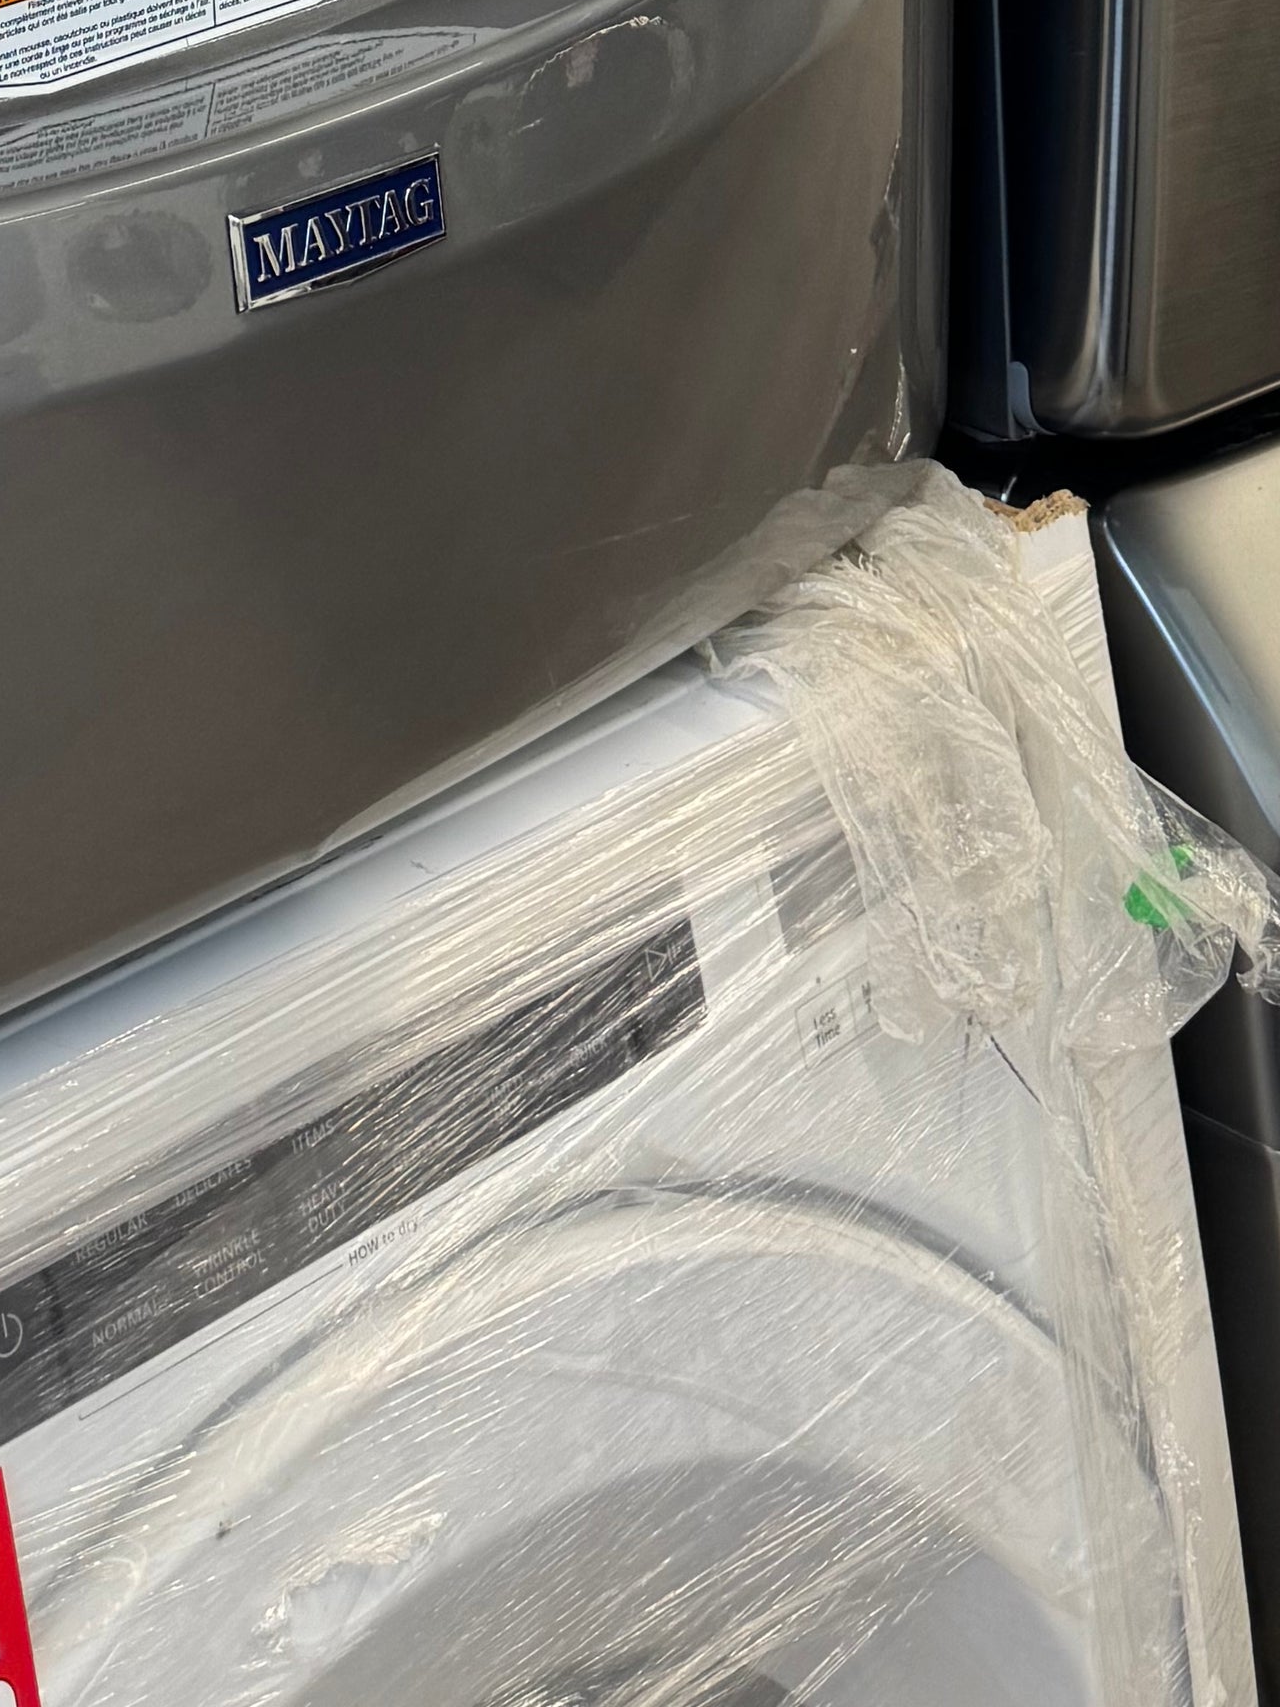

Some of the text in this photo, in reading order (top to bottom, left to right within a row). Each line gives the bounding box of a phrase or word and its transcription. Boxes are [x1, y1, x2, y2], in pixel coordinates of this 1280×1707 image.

[251, 175, 436, 286] MAYTAG
[816, 1024, 841, 1048] Time
[348, 1215, 420, 1268] HOW to dry
